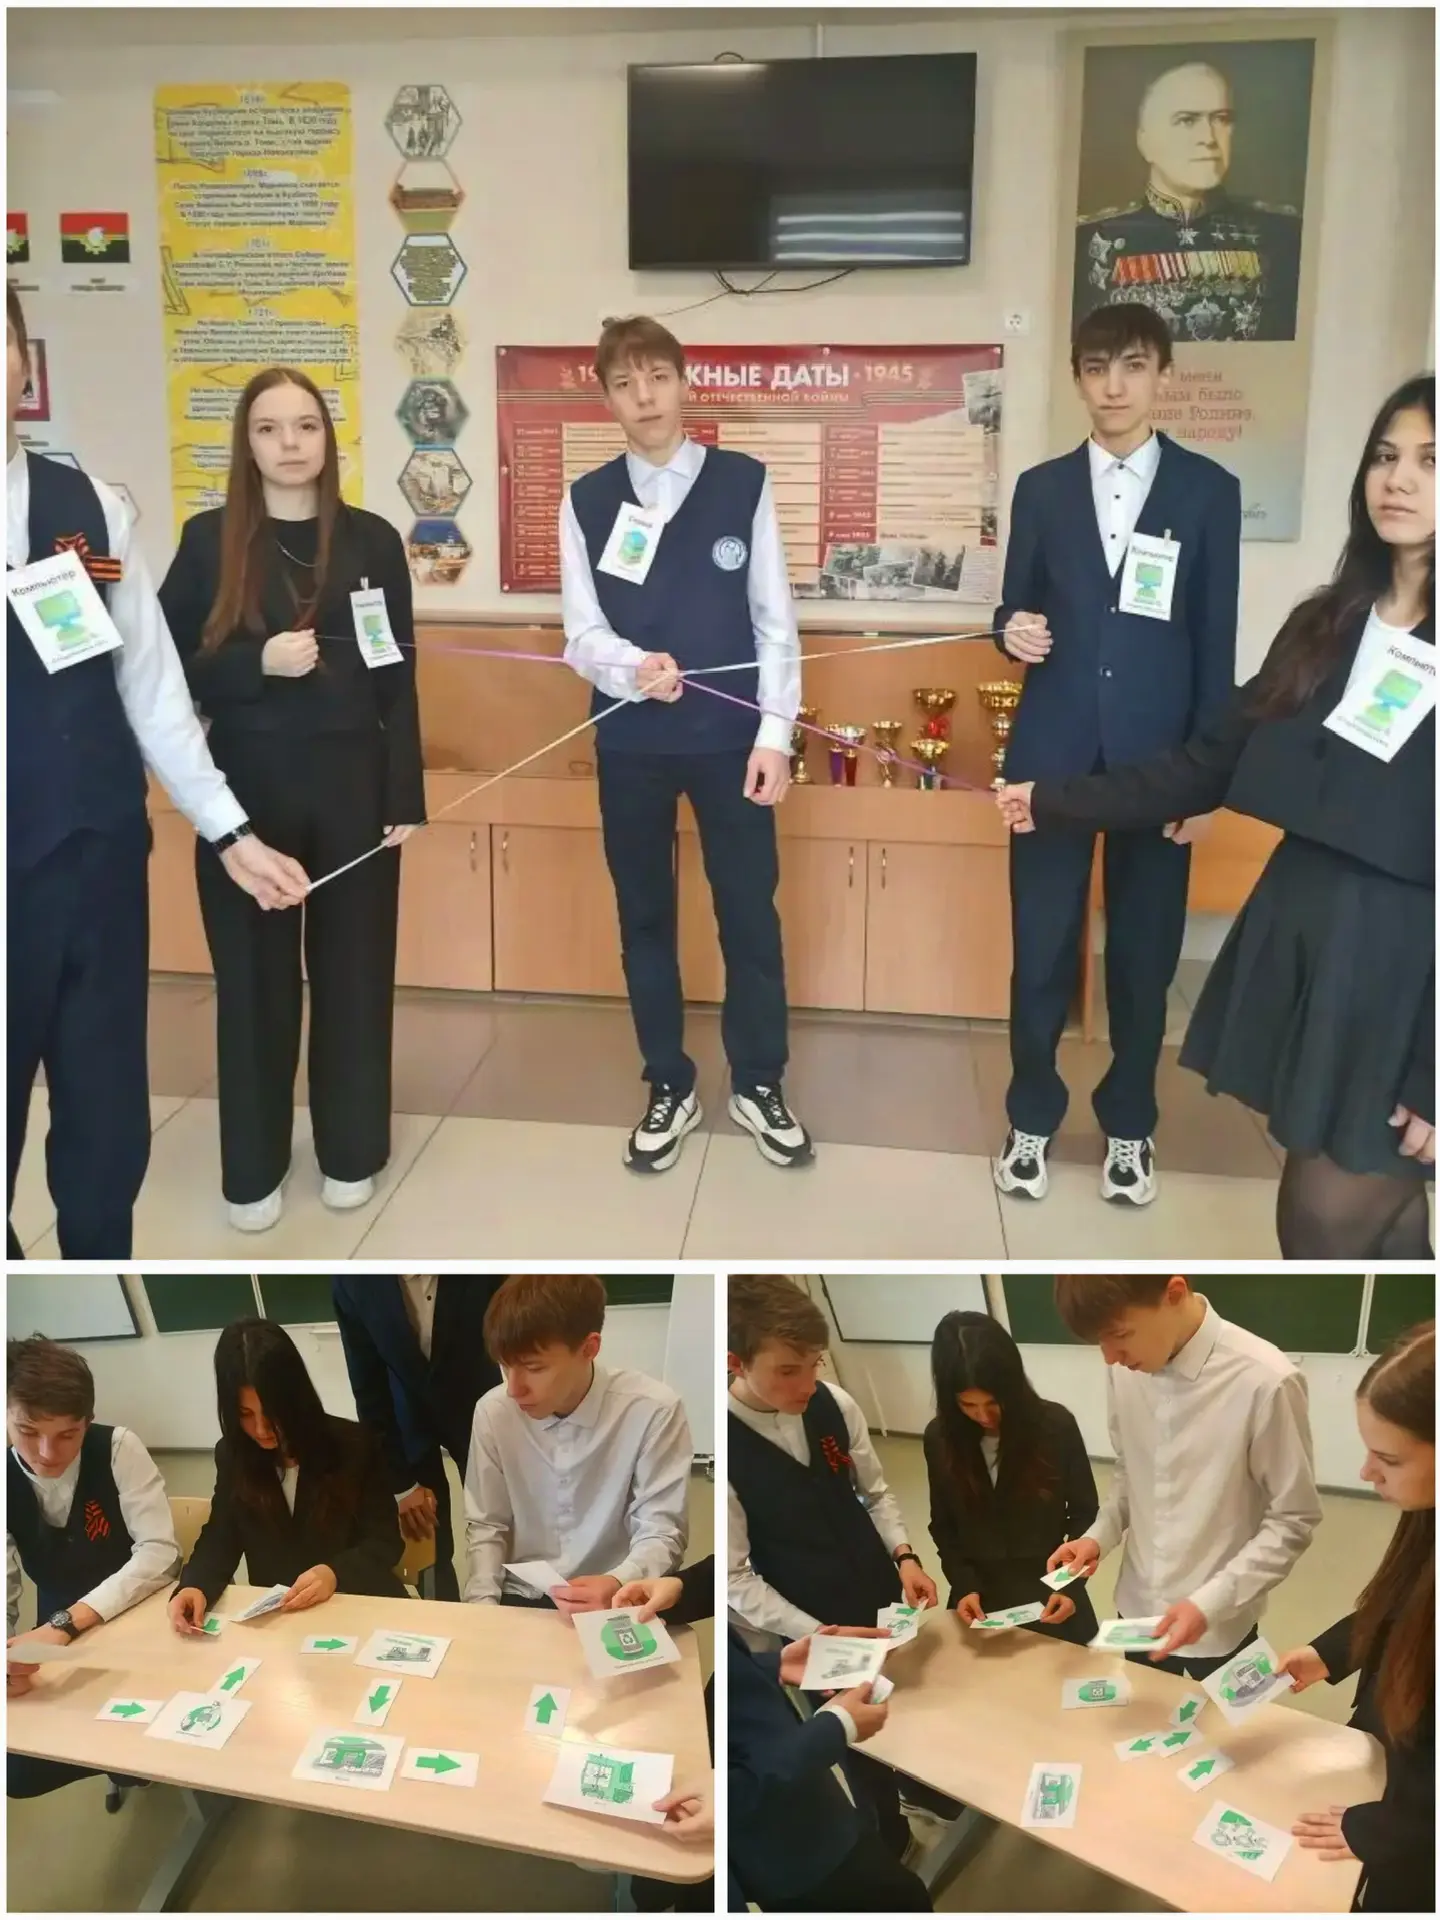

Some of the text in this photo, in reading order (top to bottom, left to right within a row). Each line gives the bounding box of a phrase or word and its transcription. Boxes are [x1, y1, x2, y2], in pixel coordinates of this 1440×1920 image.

[770, 364, 849, 390] ДАТЫ
[865, 364, 913, 383] 1945
[11, 570, 77, 597] Компьютер
